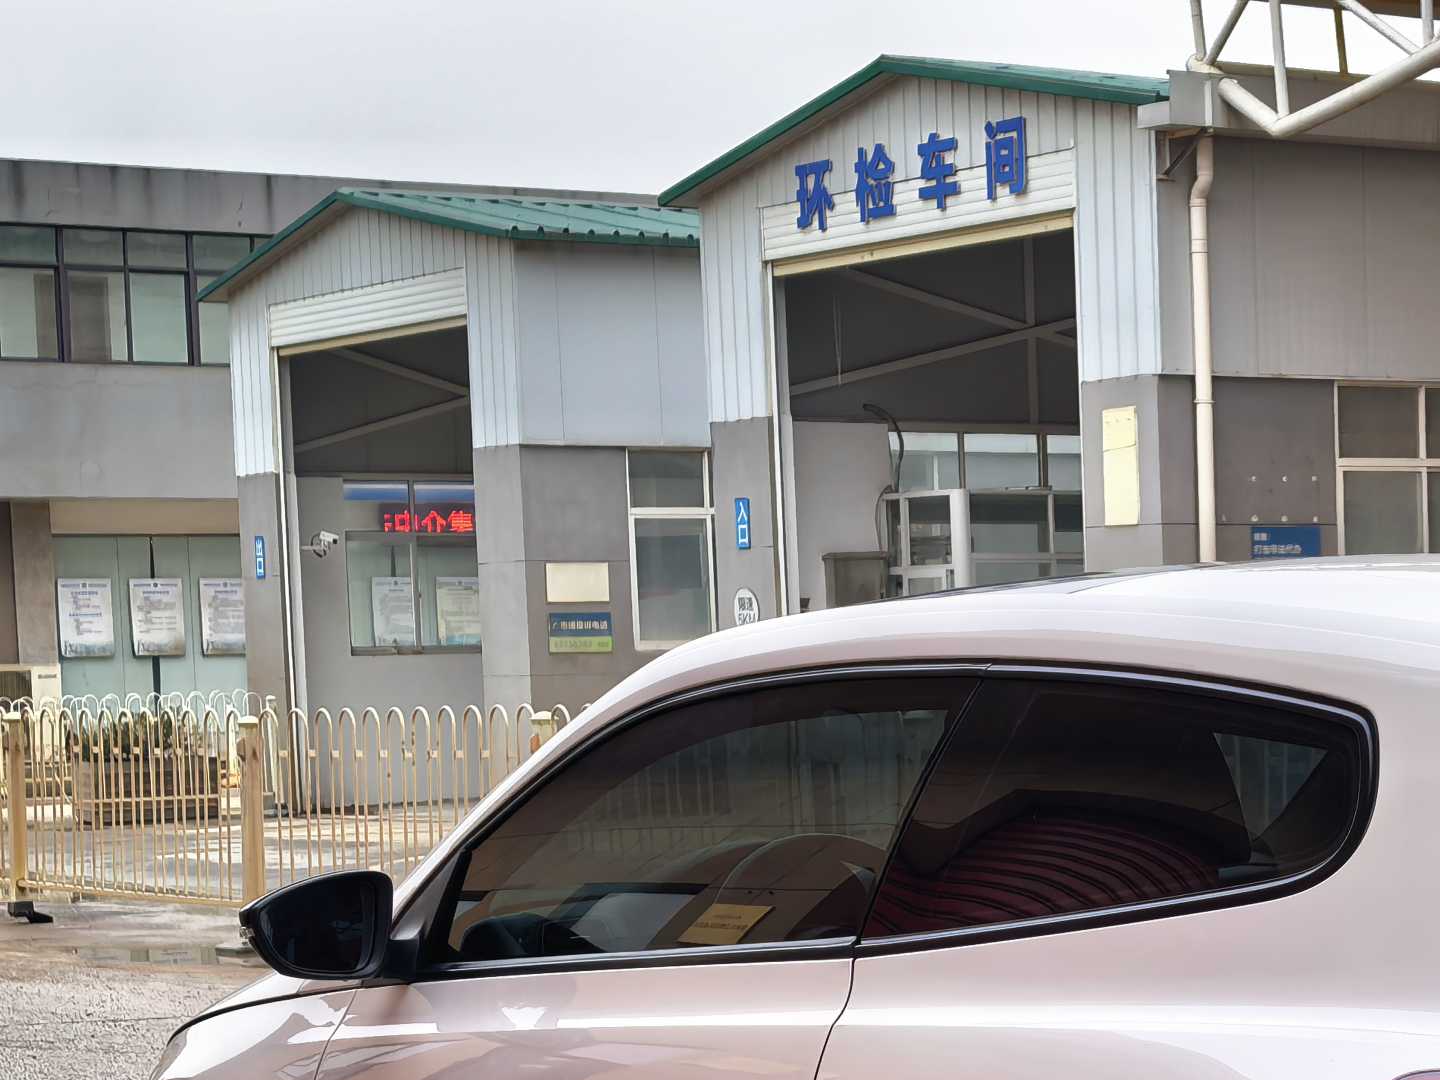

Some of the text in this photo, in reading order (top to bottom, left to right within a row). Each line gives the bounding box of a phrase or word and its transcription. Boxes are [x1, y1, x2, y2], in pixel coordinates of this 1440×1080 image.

[795, 116, 1027, 231] 环检车间
[737, 501, 749, 545] 入口
